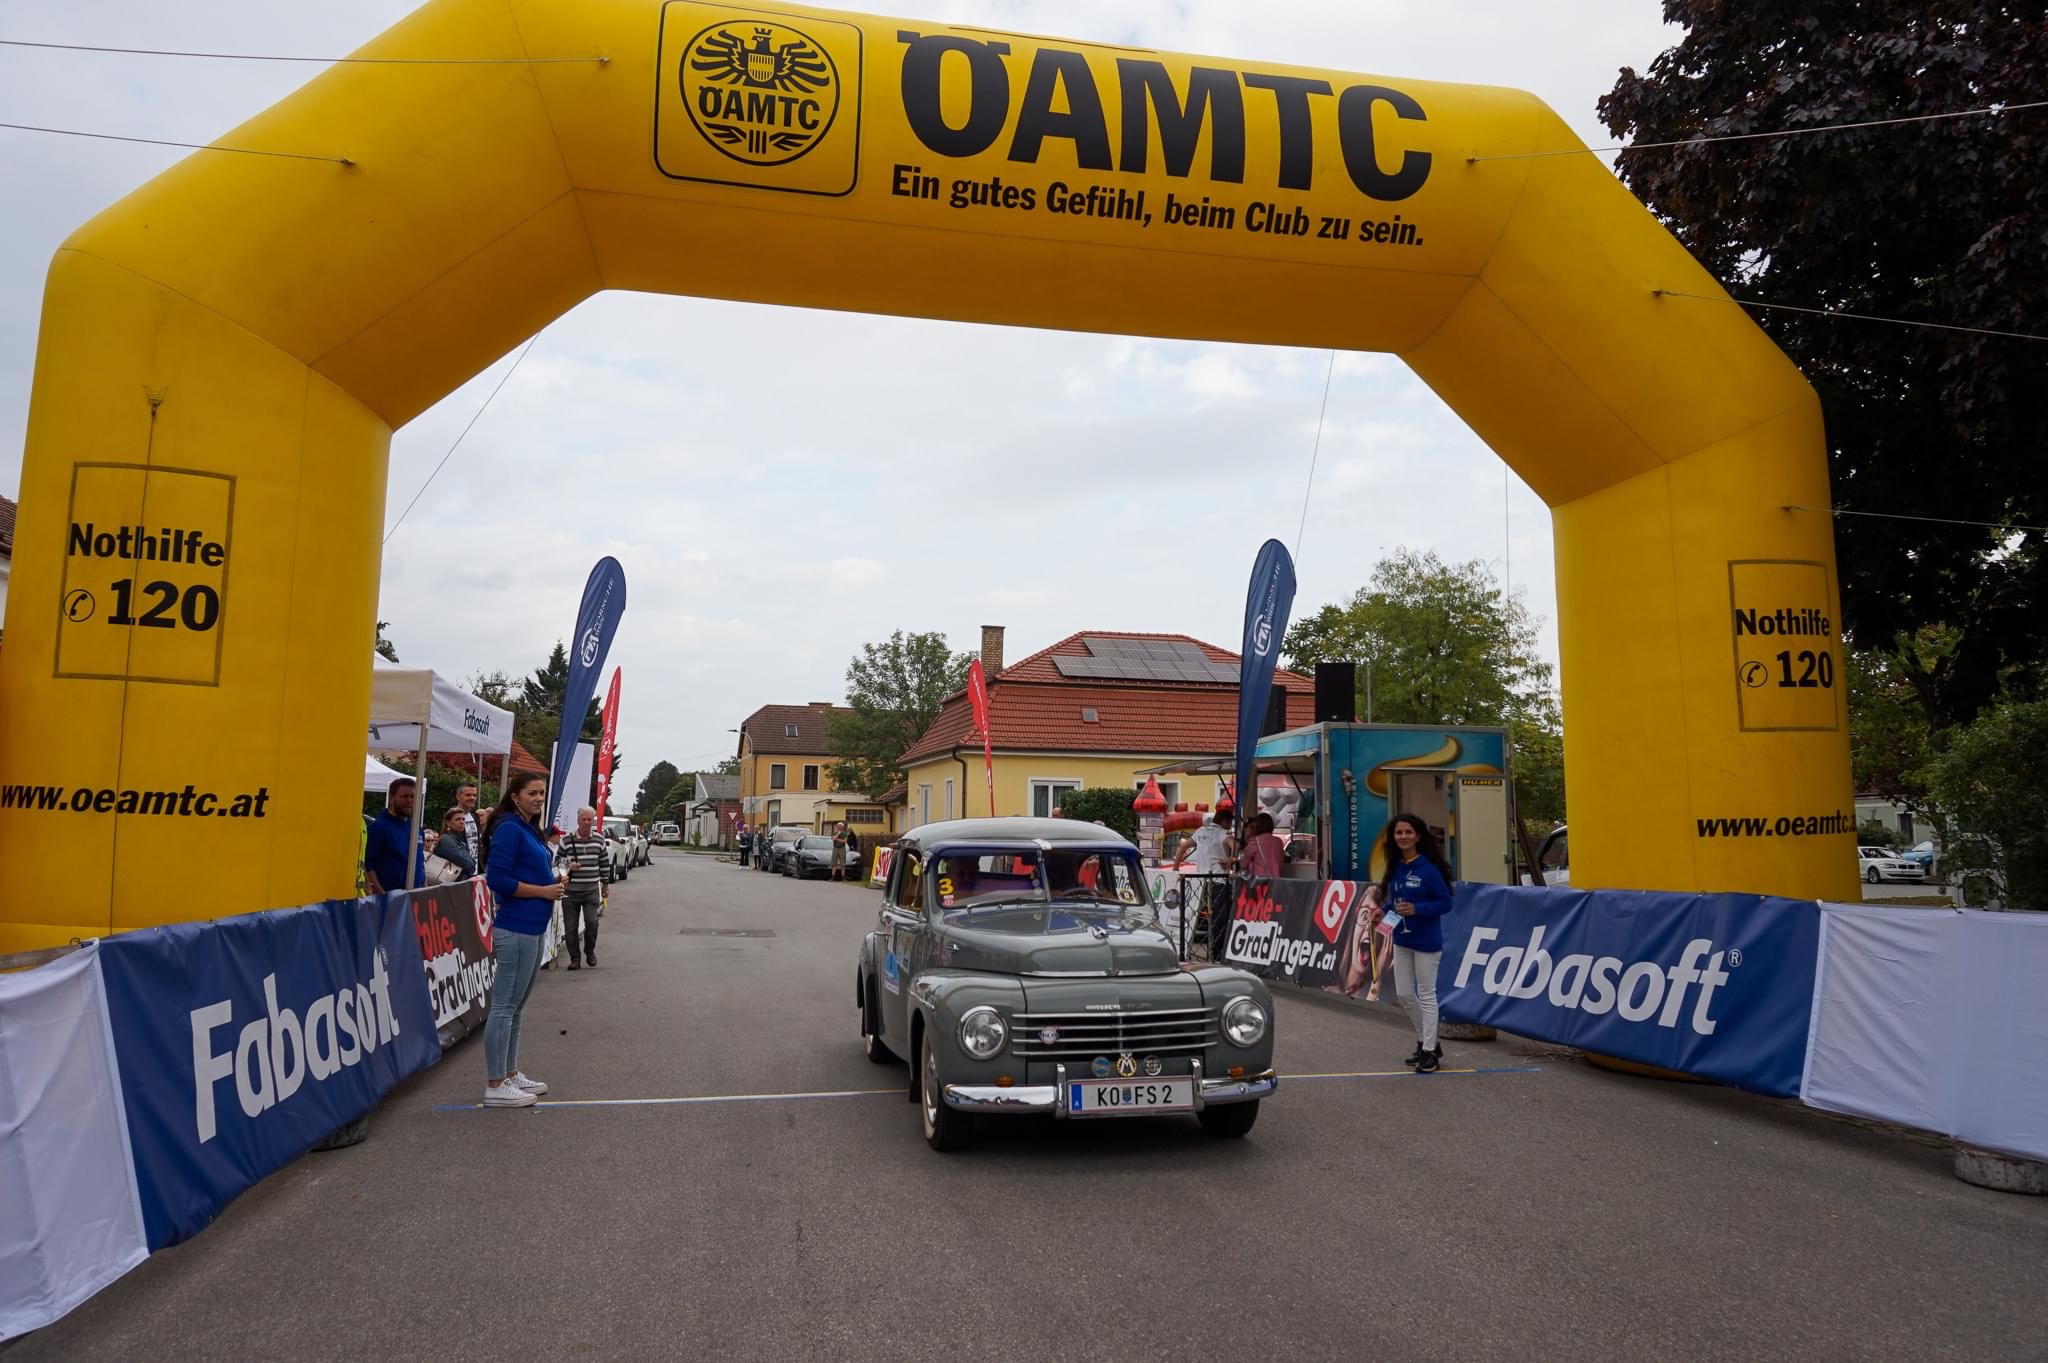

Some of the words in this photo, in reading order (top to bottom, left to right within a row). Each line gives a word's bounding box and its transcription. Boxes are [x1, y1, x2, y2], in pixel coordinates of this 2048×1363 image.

[699, 83, 820, 132] ÖAMTC
[897, 29, 1433, 202] ÖAMTC
[892, 165, 940, 199] Ein
[950, 177, 1036, 211] gutes
[1047, 182, 1152, 228] Gefühl,
[1165, 195, 1233, 230] beim
[1244, 203, 1309, 236] Club
[1317, 216, 1351, 240] zu
[1360, 213, 1424, 246] sein.
[68, 522, 225, 566] Nothilfe
[107, 579, 219, 631] 120
[1736, 608, 1829, 637] Nothilfe
[1776, 651, 1833, 688] 120
[464, 707, 490, 736] Fabasoft
[1, 784, 269, 817] www.oeamtc.at
[939, 878, 954, 895] 3
[1322, 880, 1345, 928] G
[1230, 924, 1337, 975] Gradlinger.at
[1097, 1087, 1120, 1106] KO
